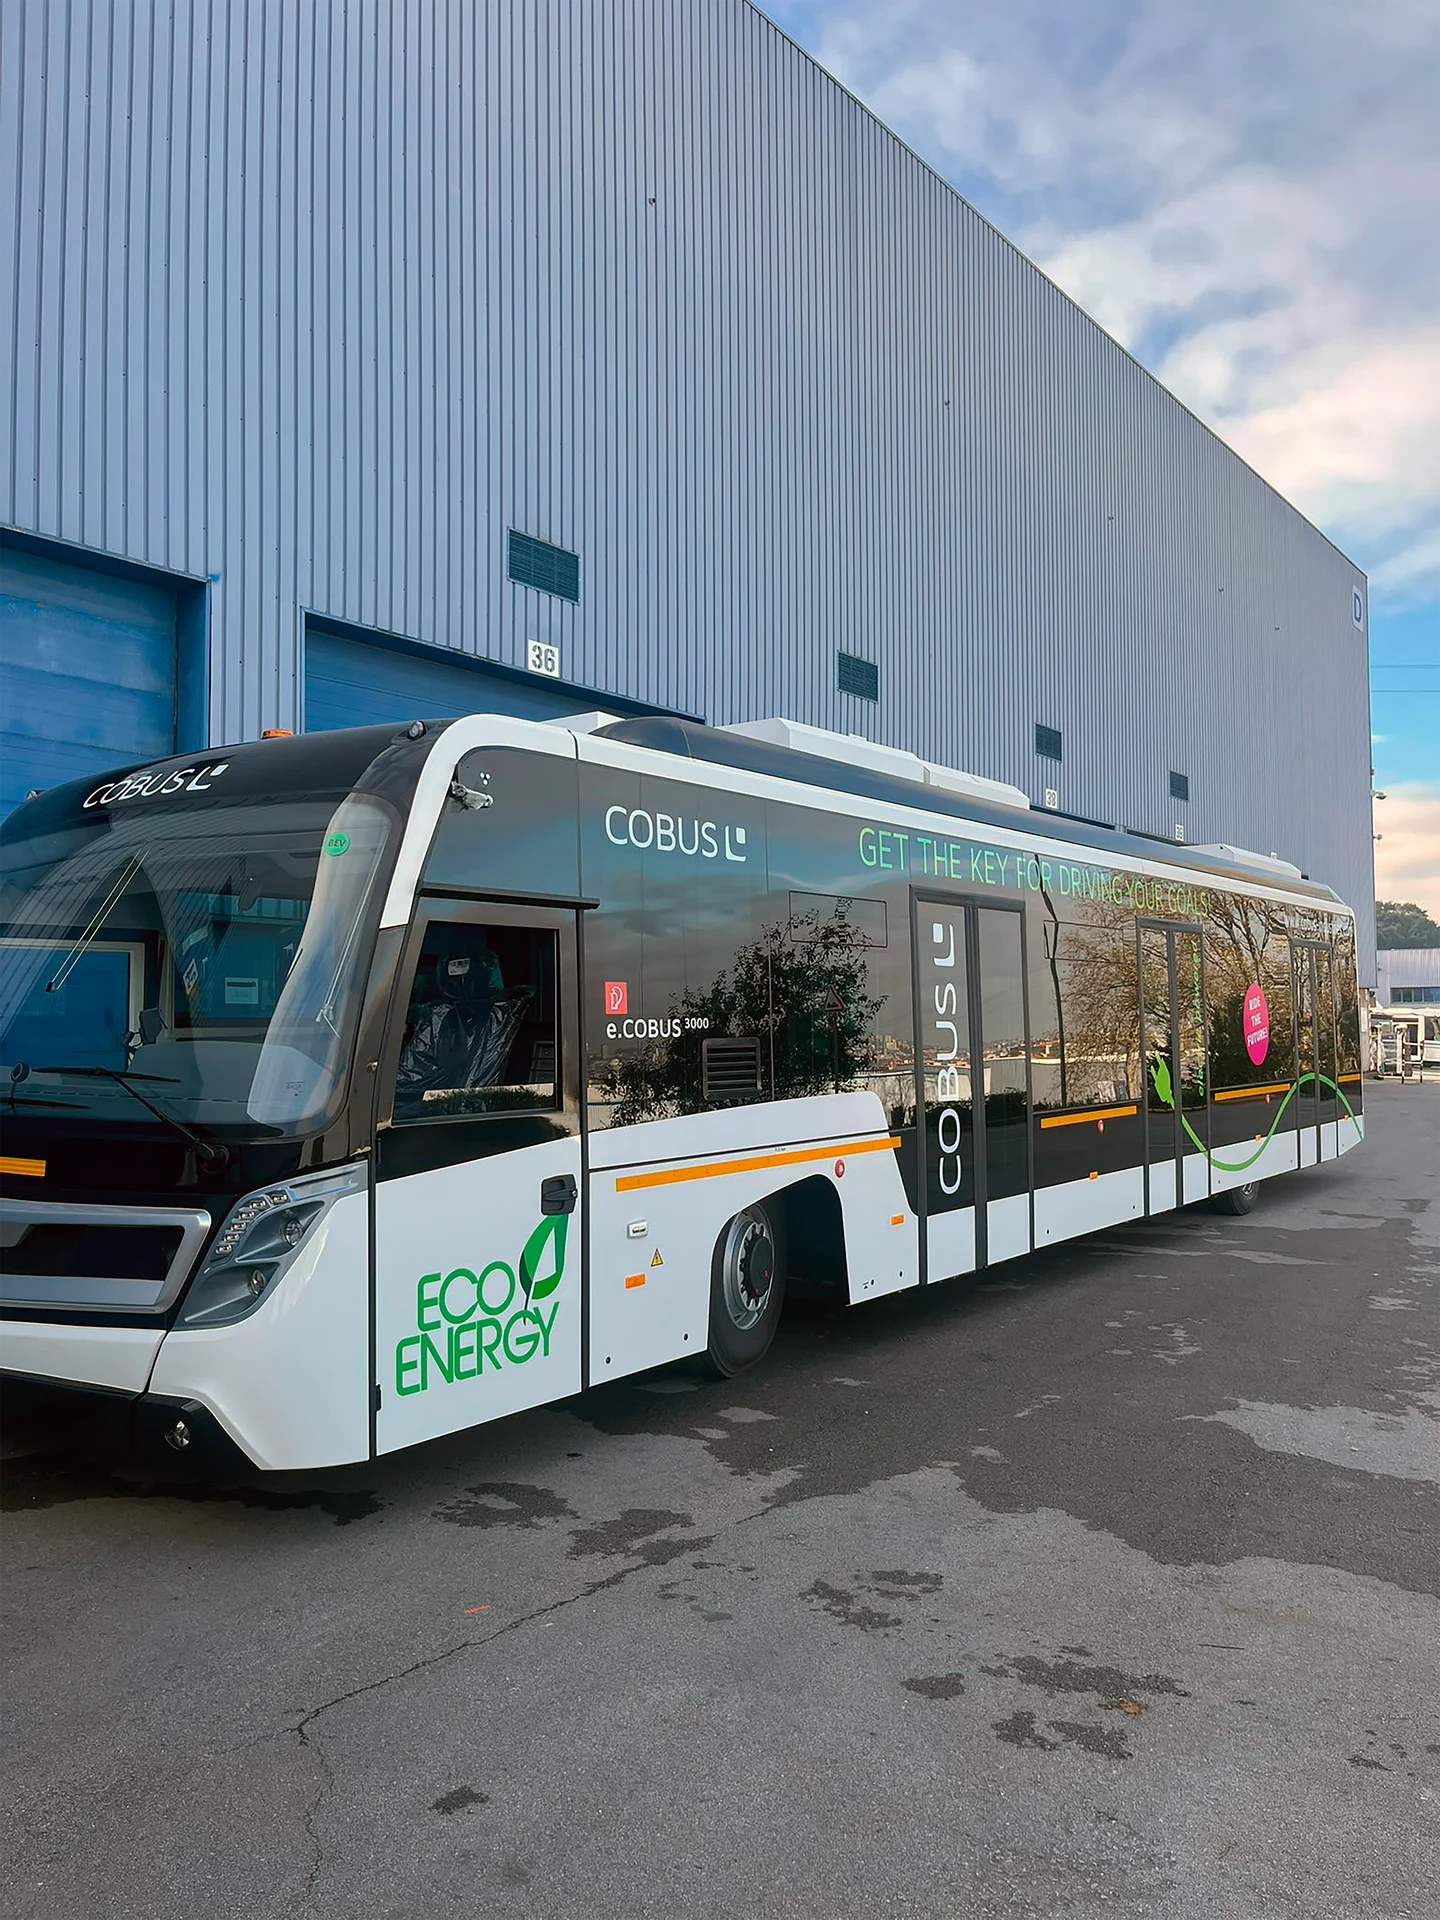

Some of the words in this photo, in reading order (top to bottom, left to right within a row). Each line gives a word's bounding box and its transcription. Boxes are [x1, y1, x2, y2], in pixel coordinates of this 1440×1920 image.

[1353, 592, 1362, 623] D
[532, 644, 556, 673] 36
[83, 768, 195, 809] COBUS
[1046, 790, 1057, 807] 38
[328, 839, 347, 847] BEV
[605, 805, 719, 858] COBUS
[859, 827, 909, 871] GET
[916, 837, 962, 880] THE
[970, 847, 1009, 886] KEY
[1016, 856, 1053, 894] FOR
[1059, 865, 1124, 905] DRIVING
[1124, 879, 1164, 912] YOUR
[1248, 995, 1261, 1011] RIDE
[606, 1018, 682, 1039] e.COBUS
[684, 1017, 709, 1029] 3000
[1250, 1013, 1262, 1027] THE
[934, 982, 962, 1195] COBUS
[417, 1260, 516, 1333] ECO
[395, 1301, 560, 1396] ENERGY
